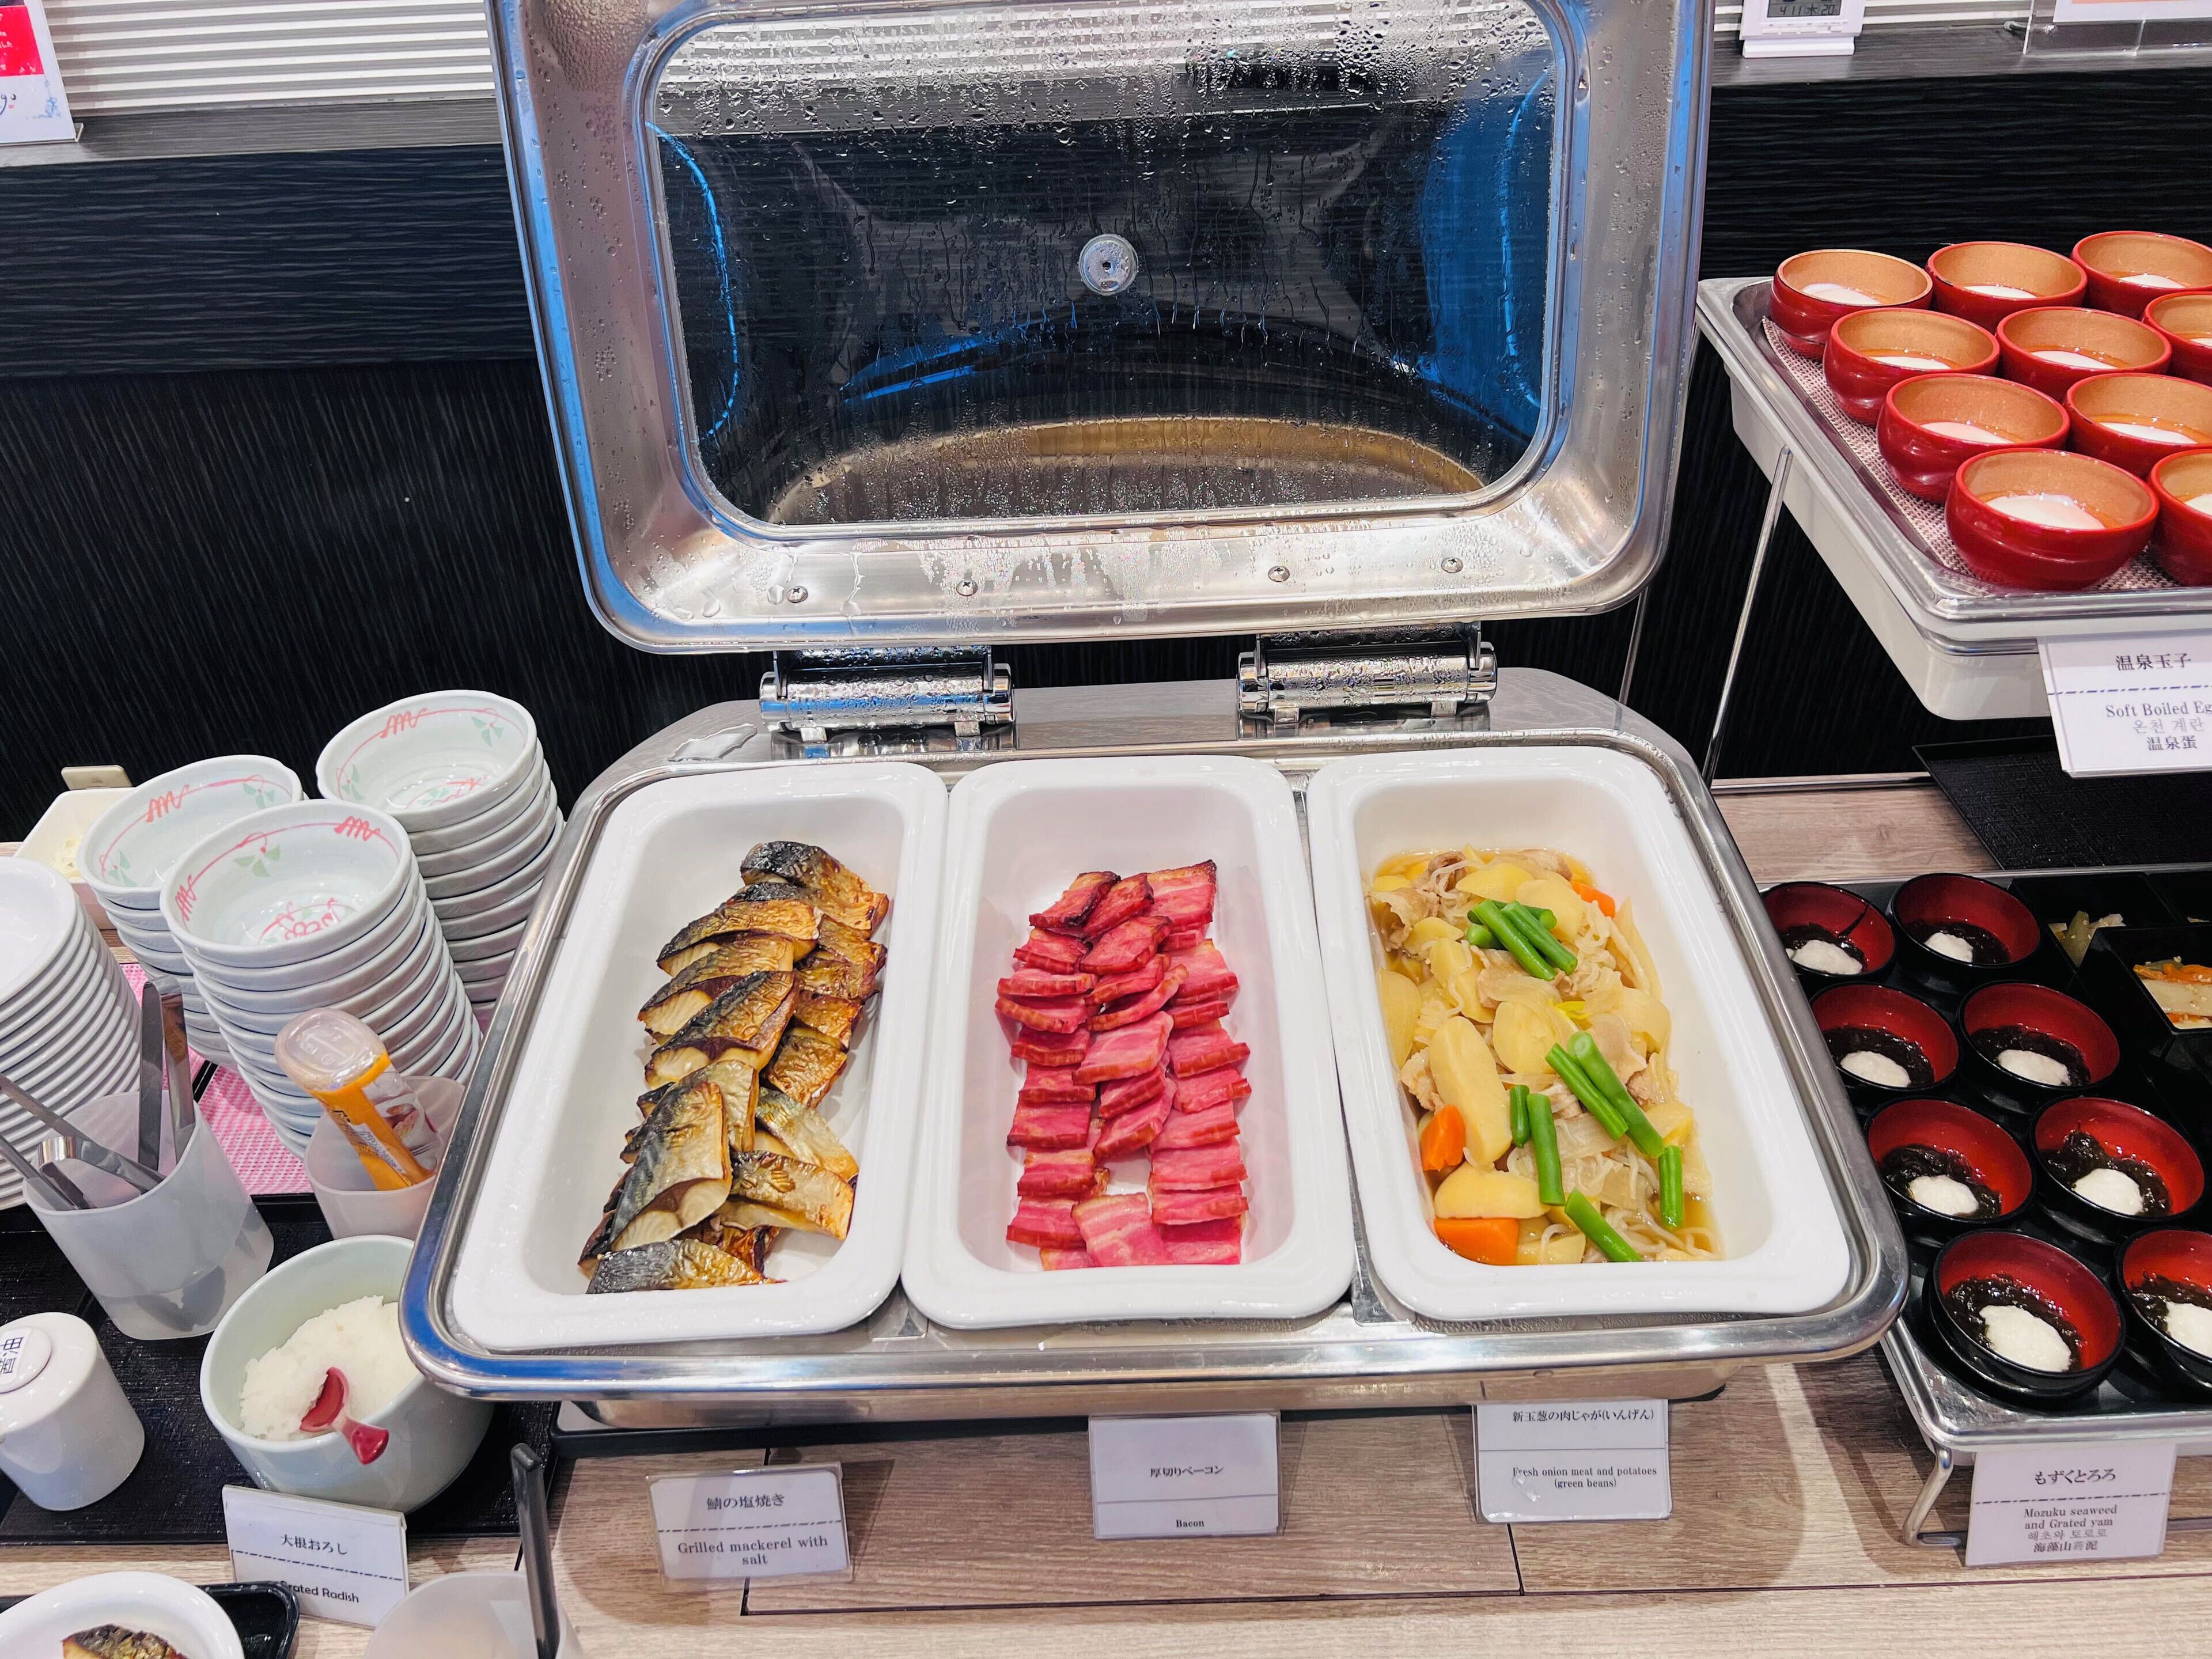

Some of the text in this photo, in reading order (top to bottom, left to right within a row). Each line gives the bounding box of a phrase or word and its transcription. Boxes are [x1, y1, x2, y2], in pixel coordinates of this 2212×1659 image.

[2115, 653, 2192, 671] 温泉玉子
[2105, 703, 2138, 718] Soft
[2142, 701, 2189, 717] Boiled
[2133, 716, 2205, 734] 온천 계란
[2147, 735, 2198, 751] 温泉蛋
[1150, 1465, 1224, 1478] 厚切りベーコン
[1513, 1466, 1657, 1476] Fresh onion meat and potatoes
[2035, 1469, 2116, 1484] もずくとろろ
[1554, 1478, 1617, 1488] (green beans)
[706, 1493, 785, 1510] 鯖の塩焼き
[2024, 1505, 2118, 1518] Mozuku seaweed
[1176, 1519, 1205, 1528] Bacon
[2025, 1518, 2113, 1529] and Grated yam
[280, 1534, 348, 1555] 大根おろし
[678, 1535, 828, 1554] Grilled mackerel with
[742, 1554, 768, 1565] salt
[321, 1588, 359, 1603] Radish
